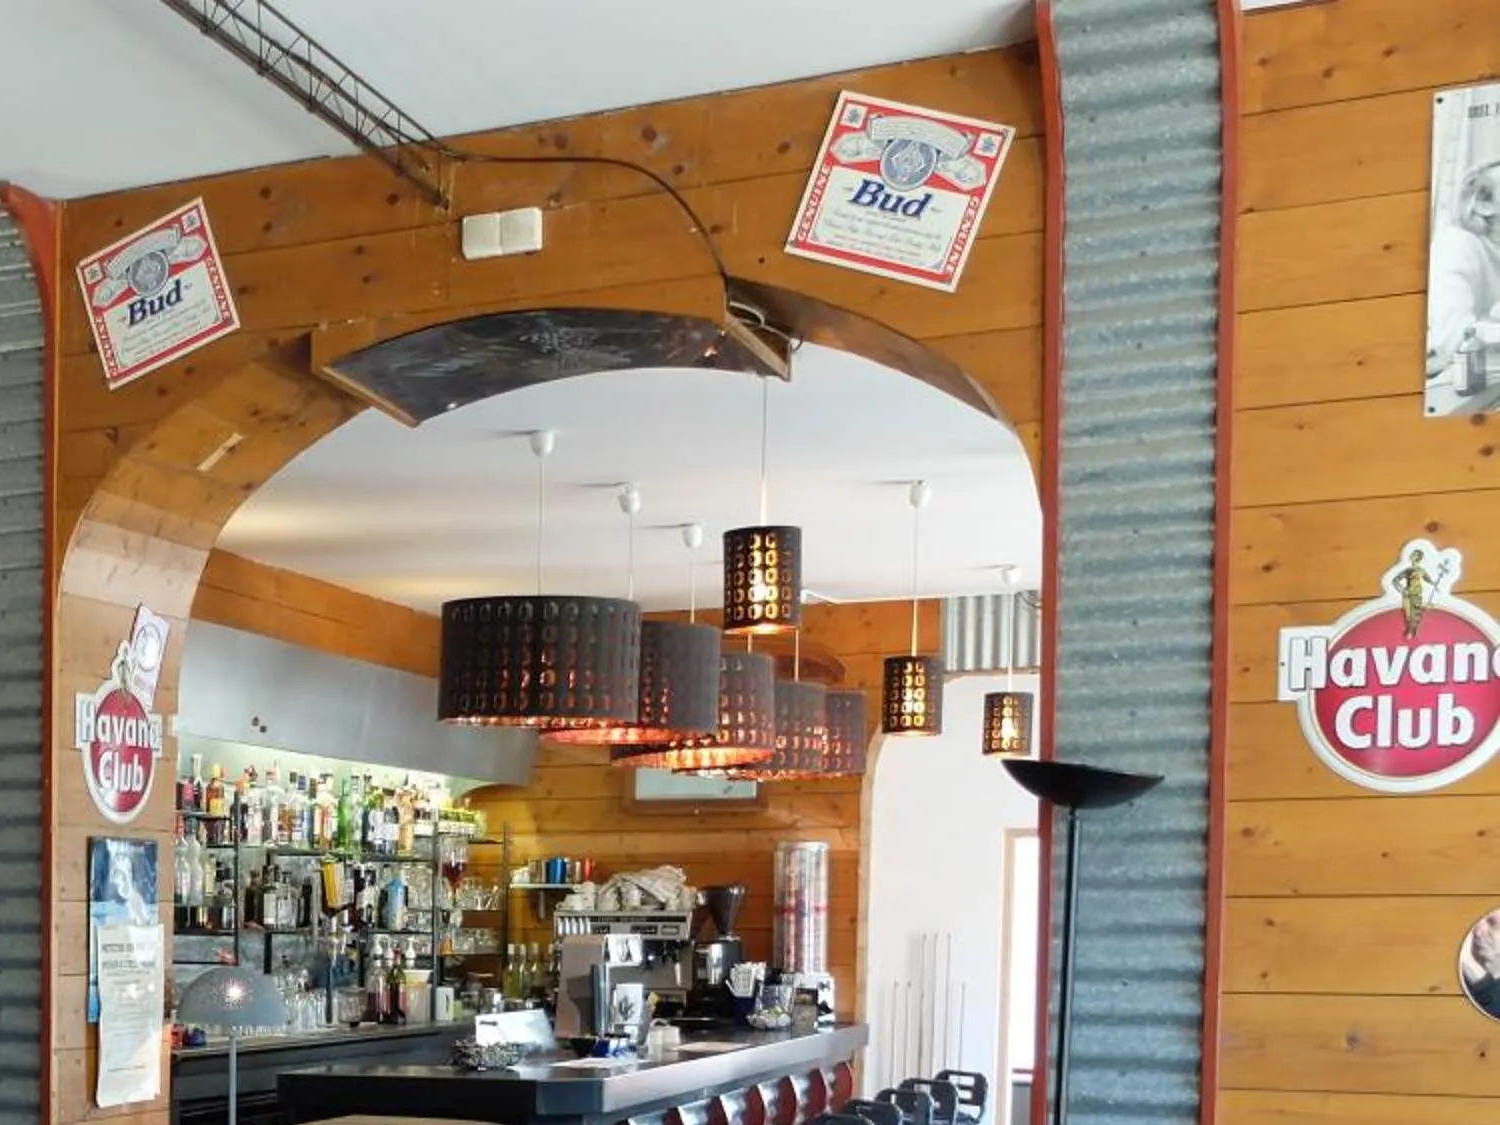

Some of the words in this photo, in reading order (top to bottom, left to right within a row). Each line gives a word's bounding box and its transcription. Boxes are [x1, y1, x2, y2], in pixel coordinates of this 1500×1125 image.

[847, 178, 933, 218] Bud
[128, 280, 182, 327] Bud
[1289, 636, 1500, 692] Havan
[80, 698, 161, 751] Havana
[1335, 693, 1474, 750] Club
[100, 751, 144, 792] Club
